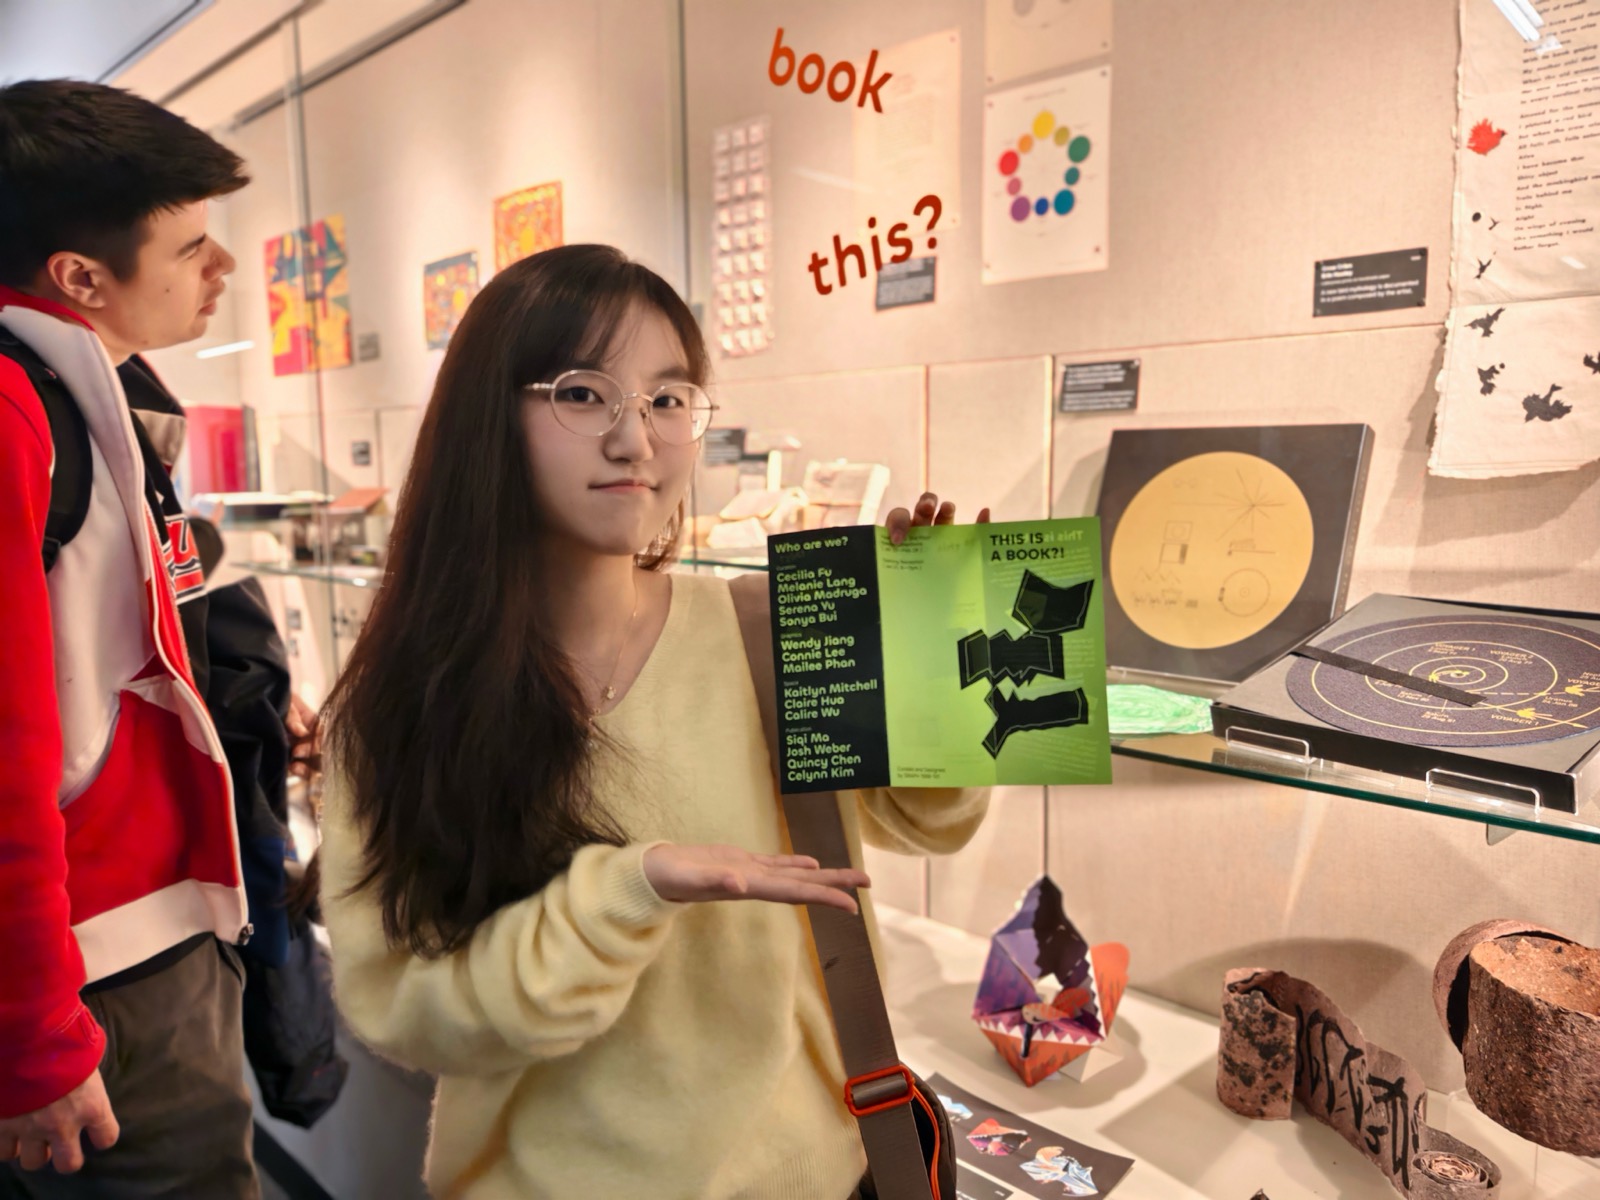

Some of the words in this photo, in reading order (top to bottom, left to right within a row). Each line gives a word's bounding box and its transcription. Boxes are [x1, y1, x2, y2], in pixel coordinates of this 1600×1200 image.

[768, 28, 893, 114] book
[808, 194, 942, 296] this?
[775, 543, 801, 553] Who
[803, 541, 821, 550] are
[824, 536, 848, 548] we?
[990, 533, 1025, 546] THIS
[1029, 532, 1044, 544] IS
[991, 550, 1001, 561] A
[1006, 547, 1065, 560] BOOK?!
[777, 569, 815, 582] Cecilia
[818, 568, 832, 578] Fu
[777, 580, 823, 593] Melanie
[826, 577, 856, 588] Lang
[778, 592, 811, 604] Olivia
[814, 588, 867, 600] Madruga
[779, 604, 818, 615] Serena
[779, 616, 816, 627] Sonya
[819, 611, 837, 623] Bui
[781, 637, 821, 650] Wendy
[824, 635, 855, 646] Jiang
[782, 649, 822, 662] Connie
[825, 648, 846, 658] Lee
[783, 662, 822, 674] Mailee
[825, 659, 856, 669] Phan
[784, 686, 826, 698] Kaitlyn
[829, 679, 878, 694] Mitchell
[784, 698, 818, 709] Claire
[821, 696, 844, 706] Hua
[785, 709, 818, 720] Calire
[821, 707, 840, 717] Wu
[1491, 714, 1532, 725] VOYAGER
[786, 734, 808, 746] Siqi
[811, 733, 830, 743] Ma
[787, 745, 811, 757] Josh
[814, 743, 851, 755] Weber
[787, 758, 828, 769] Quincy
[831, 754, 861, 765] Chen
[788, 770, 828, 782] Celynn
[831, 766, 854, 778] Kim
